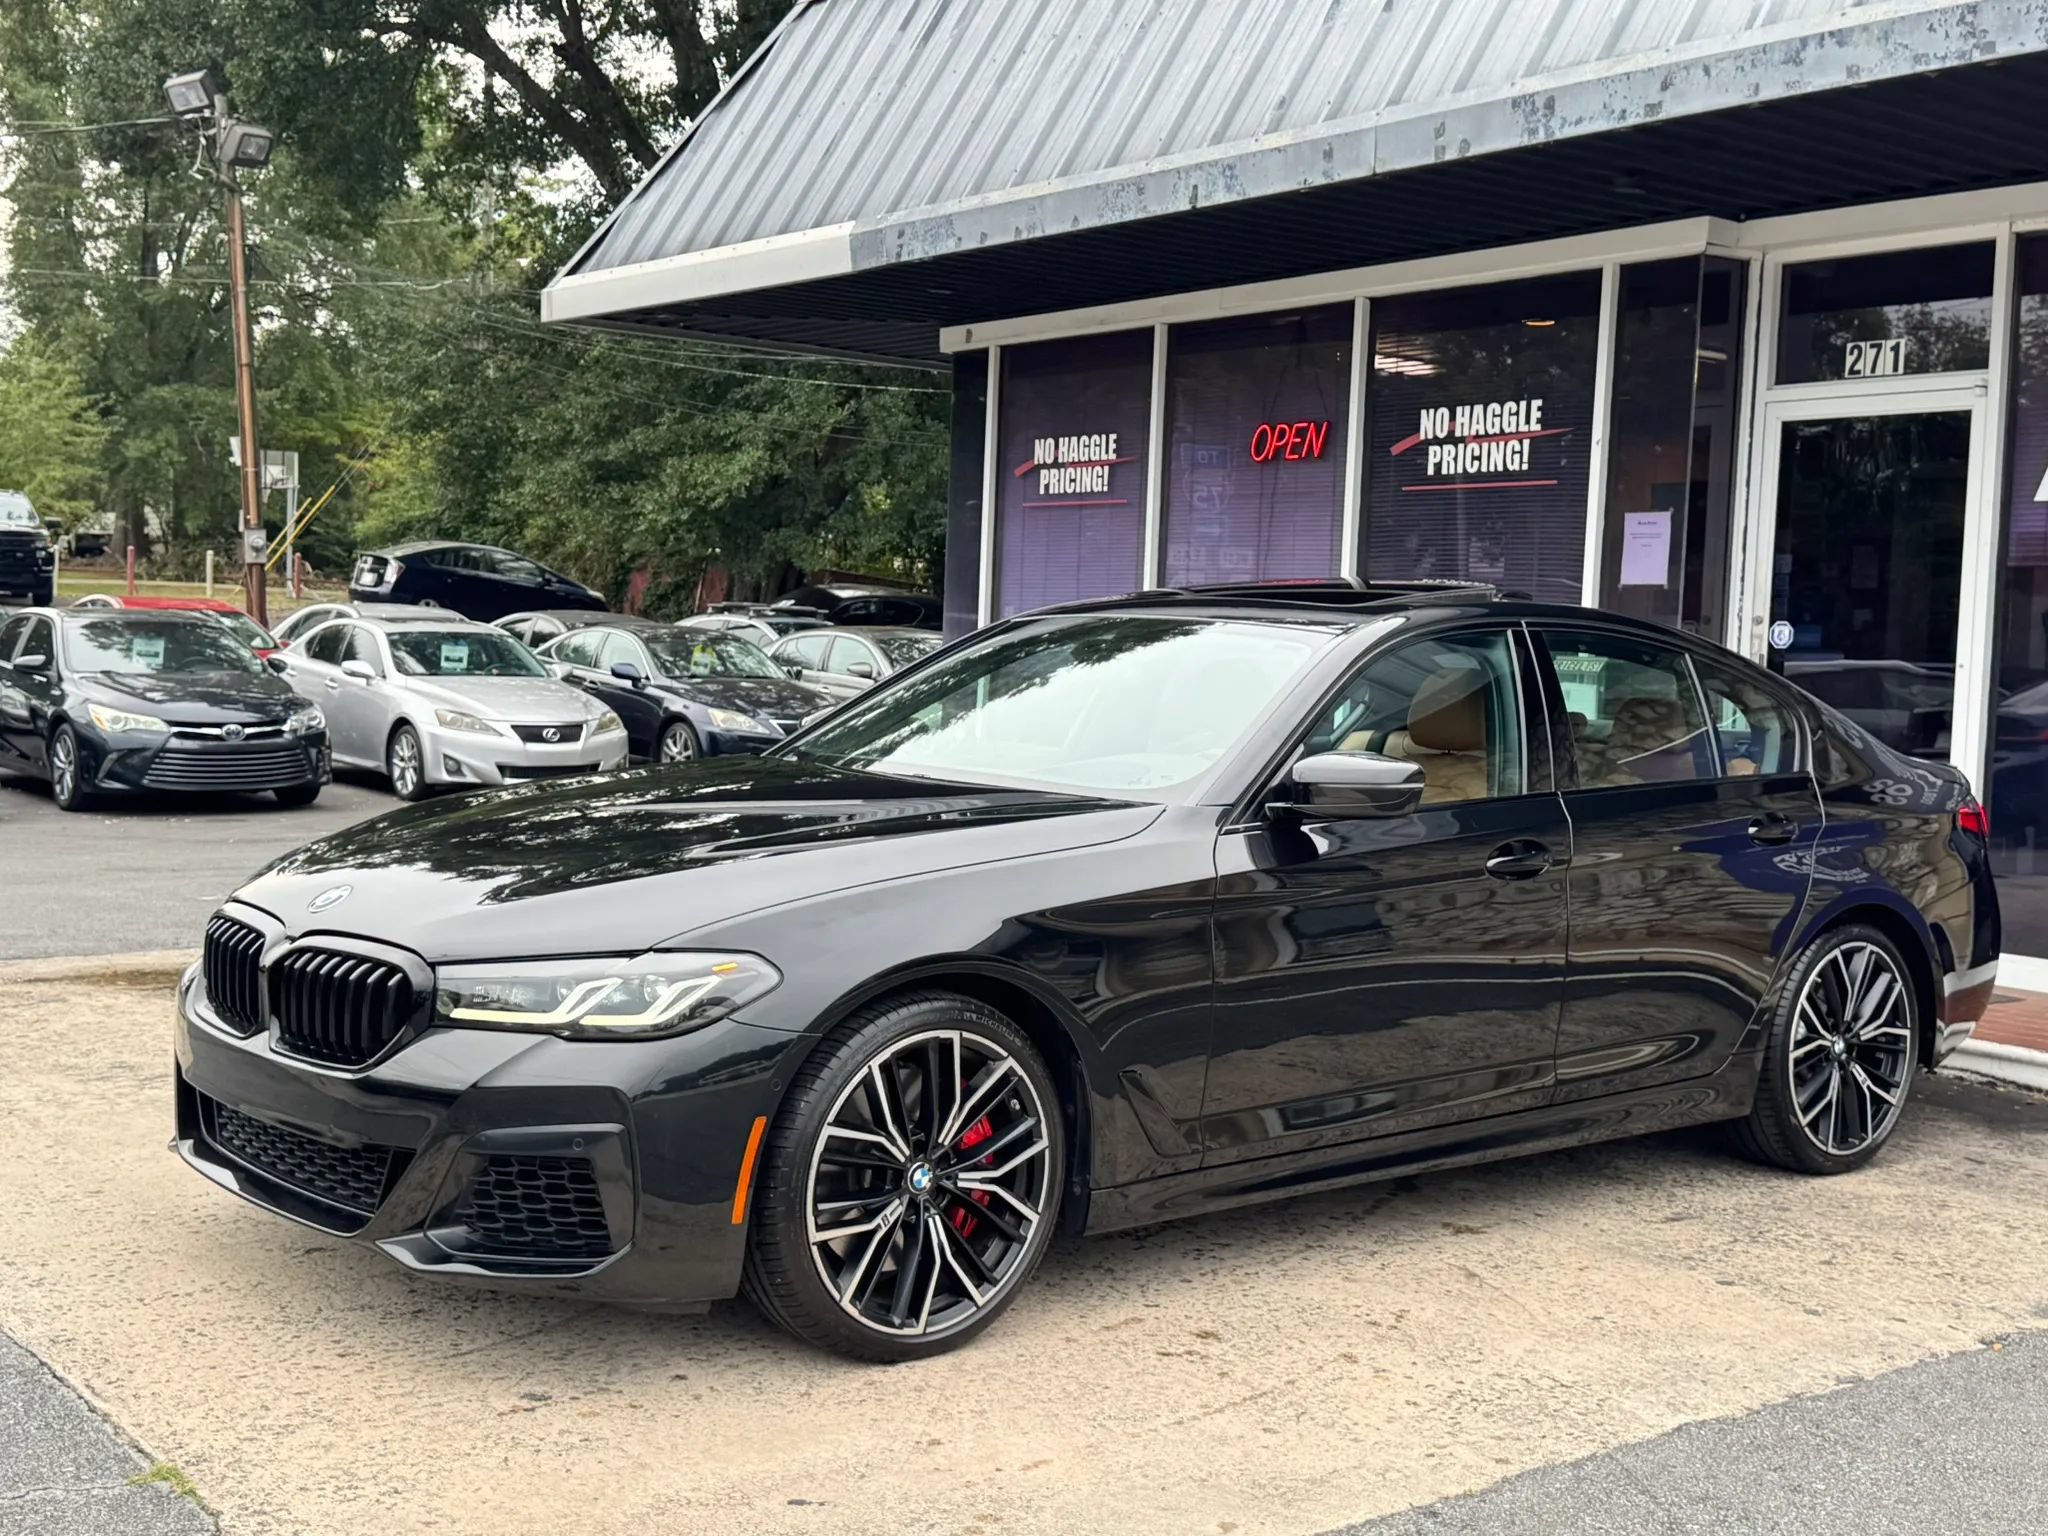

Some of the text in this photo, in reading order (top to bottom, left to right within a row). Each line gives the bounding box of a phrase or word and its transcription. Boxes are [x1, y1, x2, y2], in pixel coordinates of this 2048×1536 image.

[1847, 341, 1901, 375] 271
[1419, 399, 1543, 440] NO HAGGLE
[1034, 433, 1117, 464] NO HAGGLE
[1251, 421, 1329, 462] OPEN
[1427, 439, 1531, 476] PRICING!
[1039, 465, 1109, 494] PRICING!
